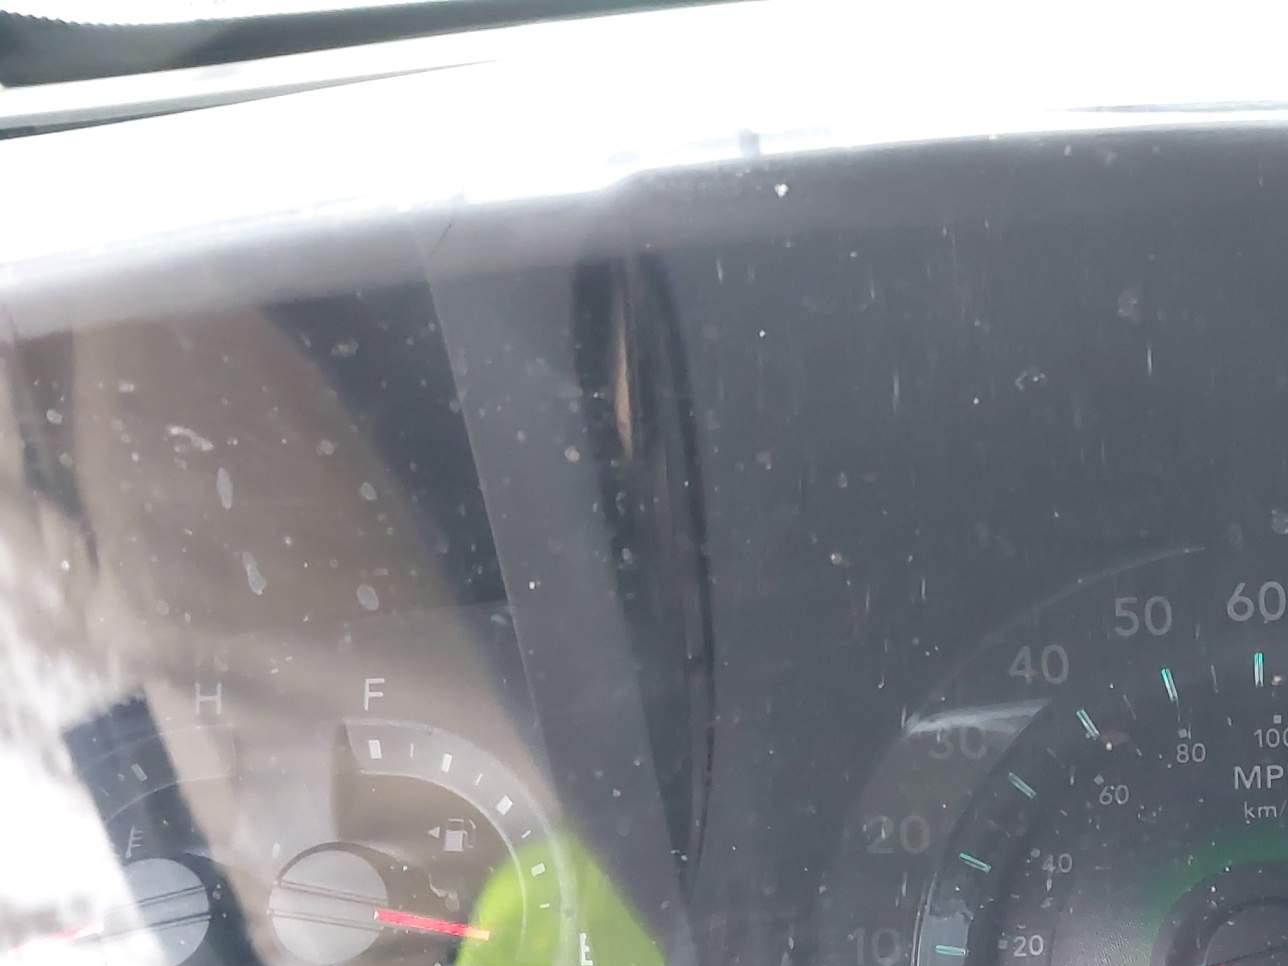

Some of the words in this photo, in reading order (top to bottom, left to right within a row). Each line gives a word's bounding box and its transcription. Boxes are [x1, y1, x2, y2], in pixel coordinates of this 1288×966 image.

[1114, 597, 1173, 637] 50
[1226, 581, 1287, 622] 60
[1009, 645, 1070, 684] 40
[194, 682, 223, 715] H
[364, 678, 385, 711] F
[1176, 743, 1206, 763] 80
[1099, 785, 1129, 805] 60
[865, 815, 930, 855] 20
[1042, 853, 1073, 874] 40
[851, 928, 902, 966] 10
[1013, 935, 1044, 956] 20
